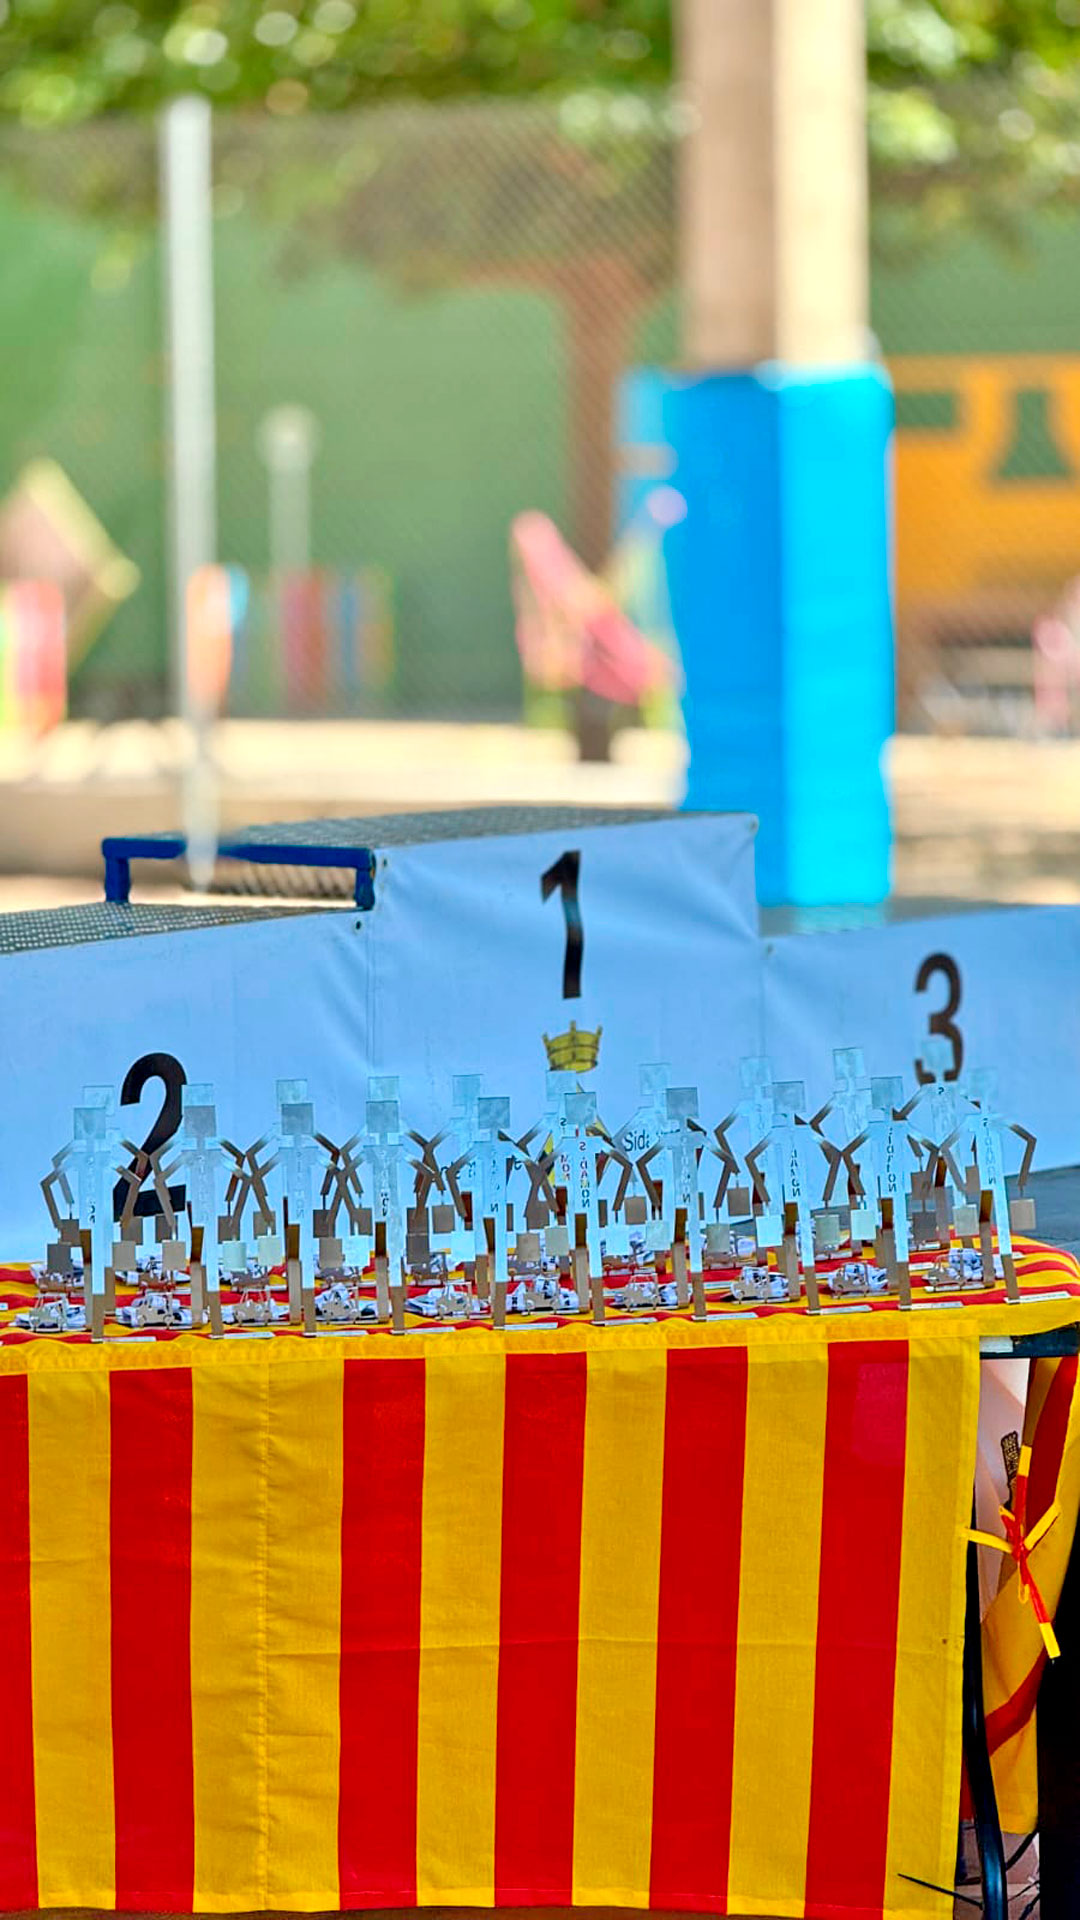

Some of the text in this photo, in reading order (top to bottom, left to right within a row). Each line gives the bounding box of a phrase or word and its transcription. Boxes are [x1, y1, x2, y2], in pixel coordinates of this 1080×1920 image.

[540, 849, 584, 1000] 1
[914, 952, 963, 1085] 3
[112, 1052, 188, 1222] 2
